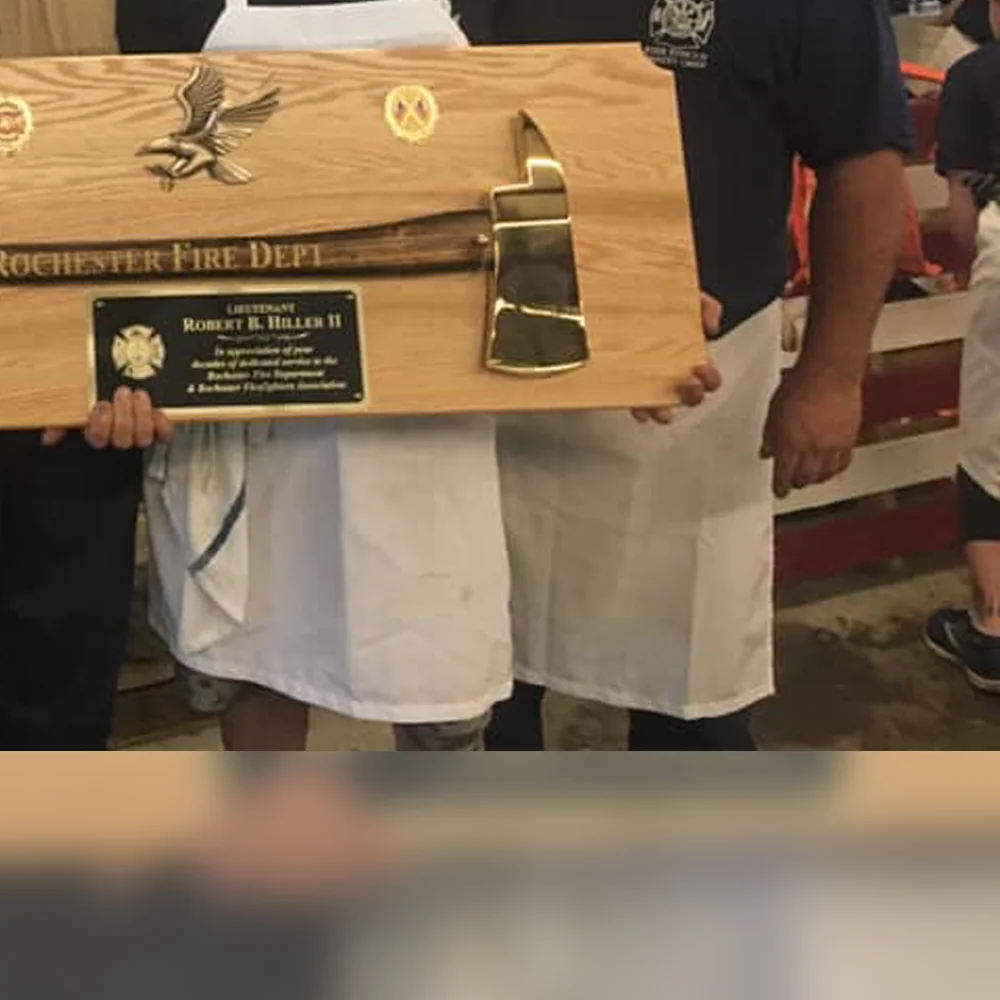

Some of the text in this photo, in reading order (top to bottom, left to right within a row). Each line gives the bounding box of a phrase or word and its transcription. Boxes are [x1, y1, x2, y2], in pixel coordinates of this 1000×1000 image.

[172, 242, 239, 271] FIRE
[249, 241, 323, 269] DEPT
[183, 317, 244, 332] ROBERT
